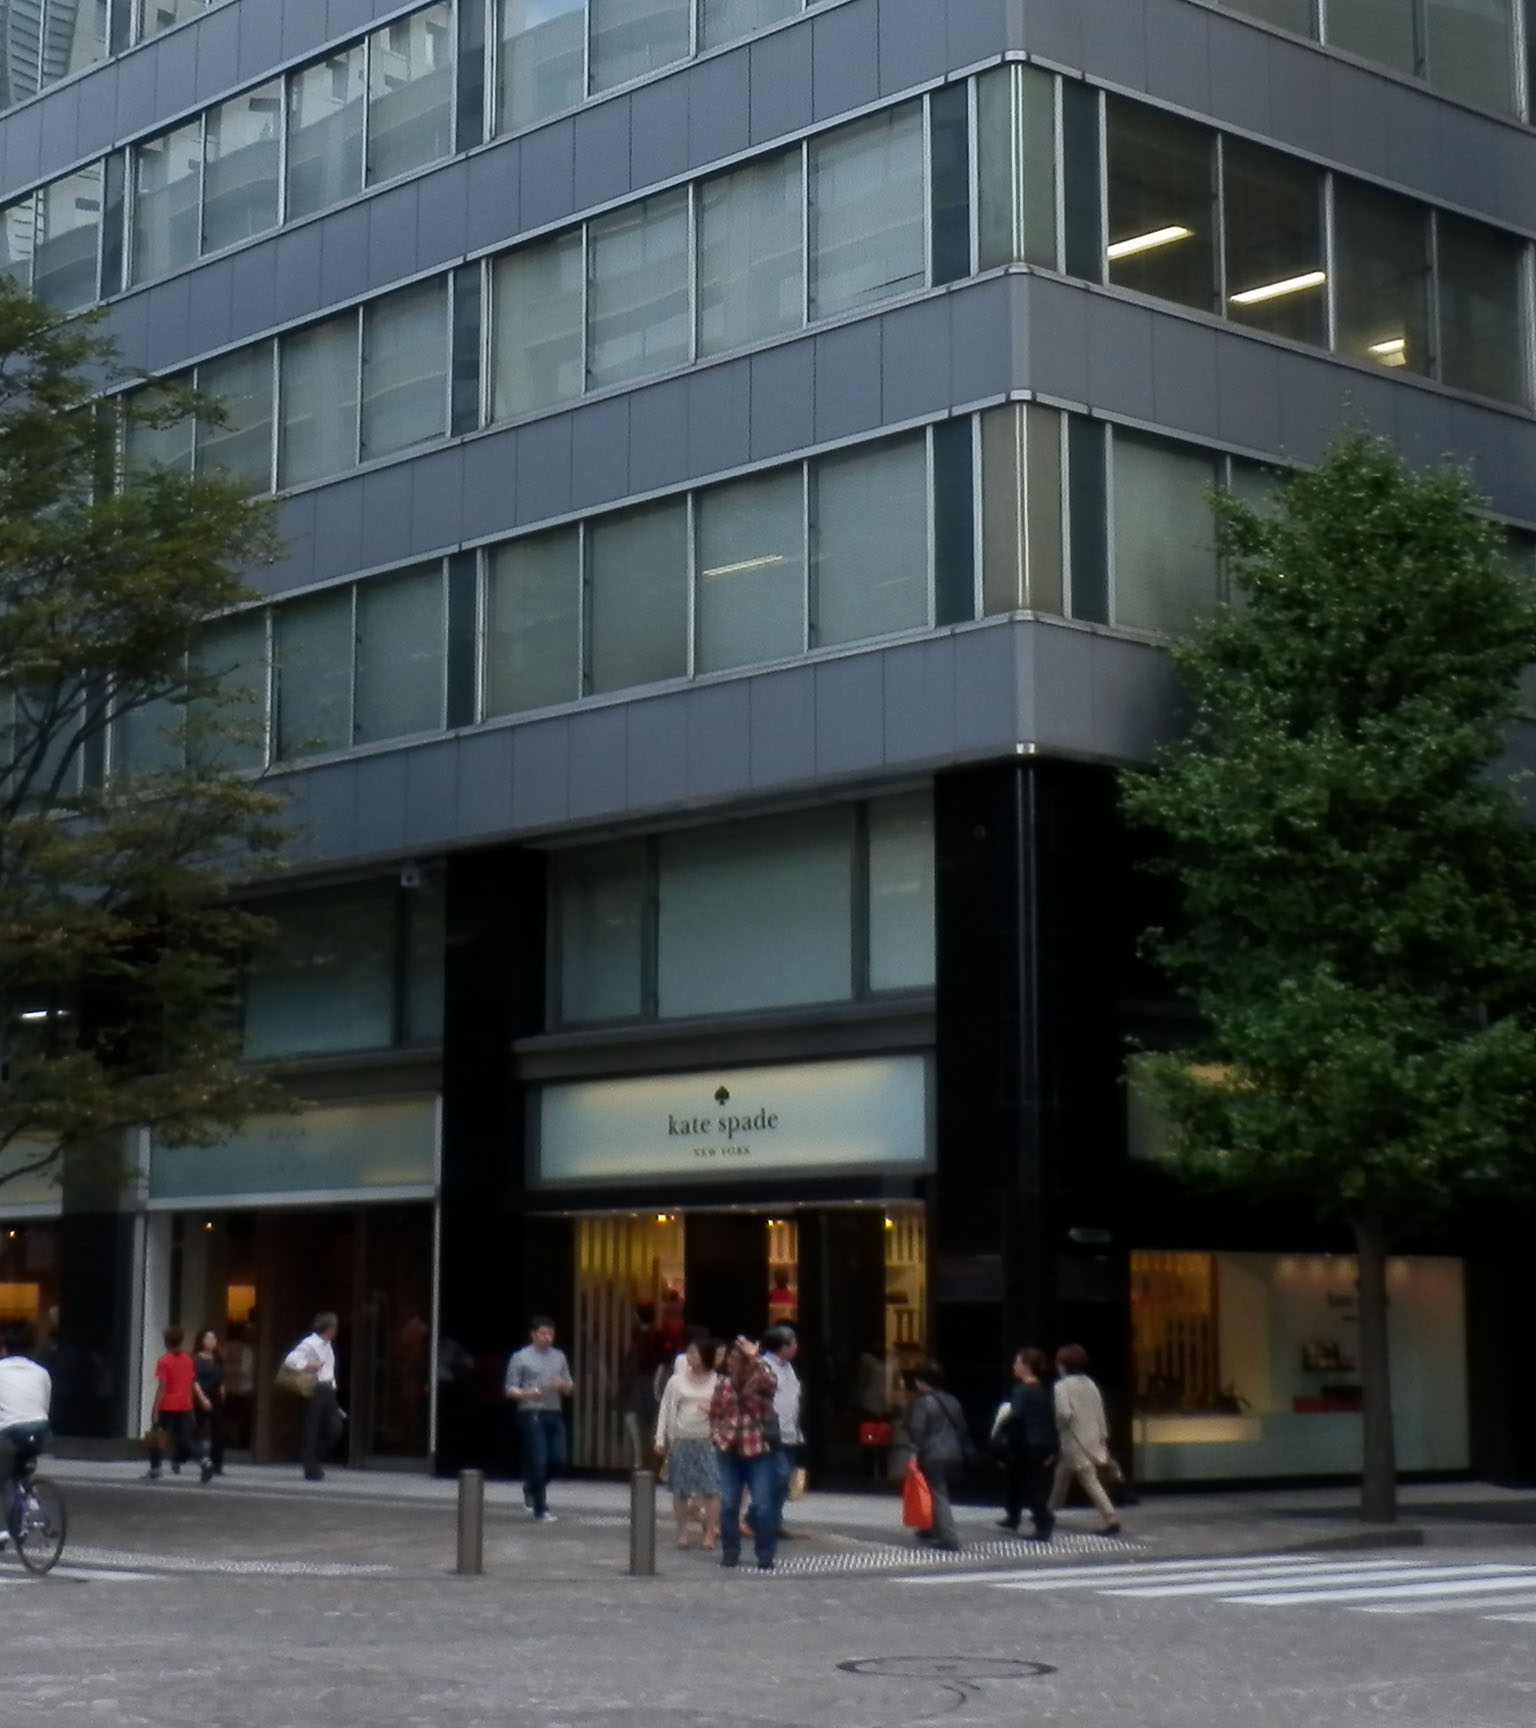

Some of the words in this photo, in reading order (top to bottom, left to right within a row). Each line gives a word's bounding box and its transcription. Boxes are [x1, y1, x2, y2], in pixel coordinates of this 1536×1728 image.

[668, 1114, 711, 1135] kate
[718, 1107, 779, 1140] spade
[693, 1148, 716, 1157] NEW
[719, 1145, 751, 1155] YORK
